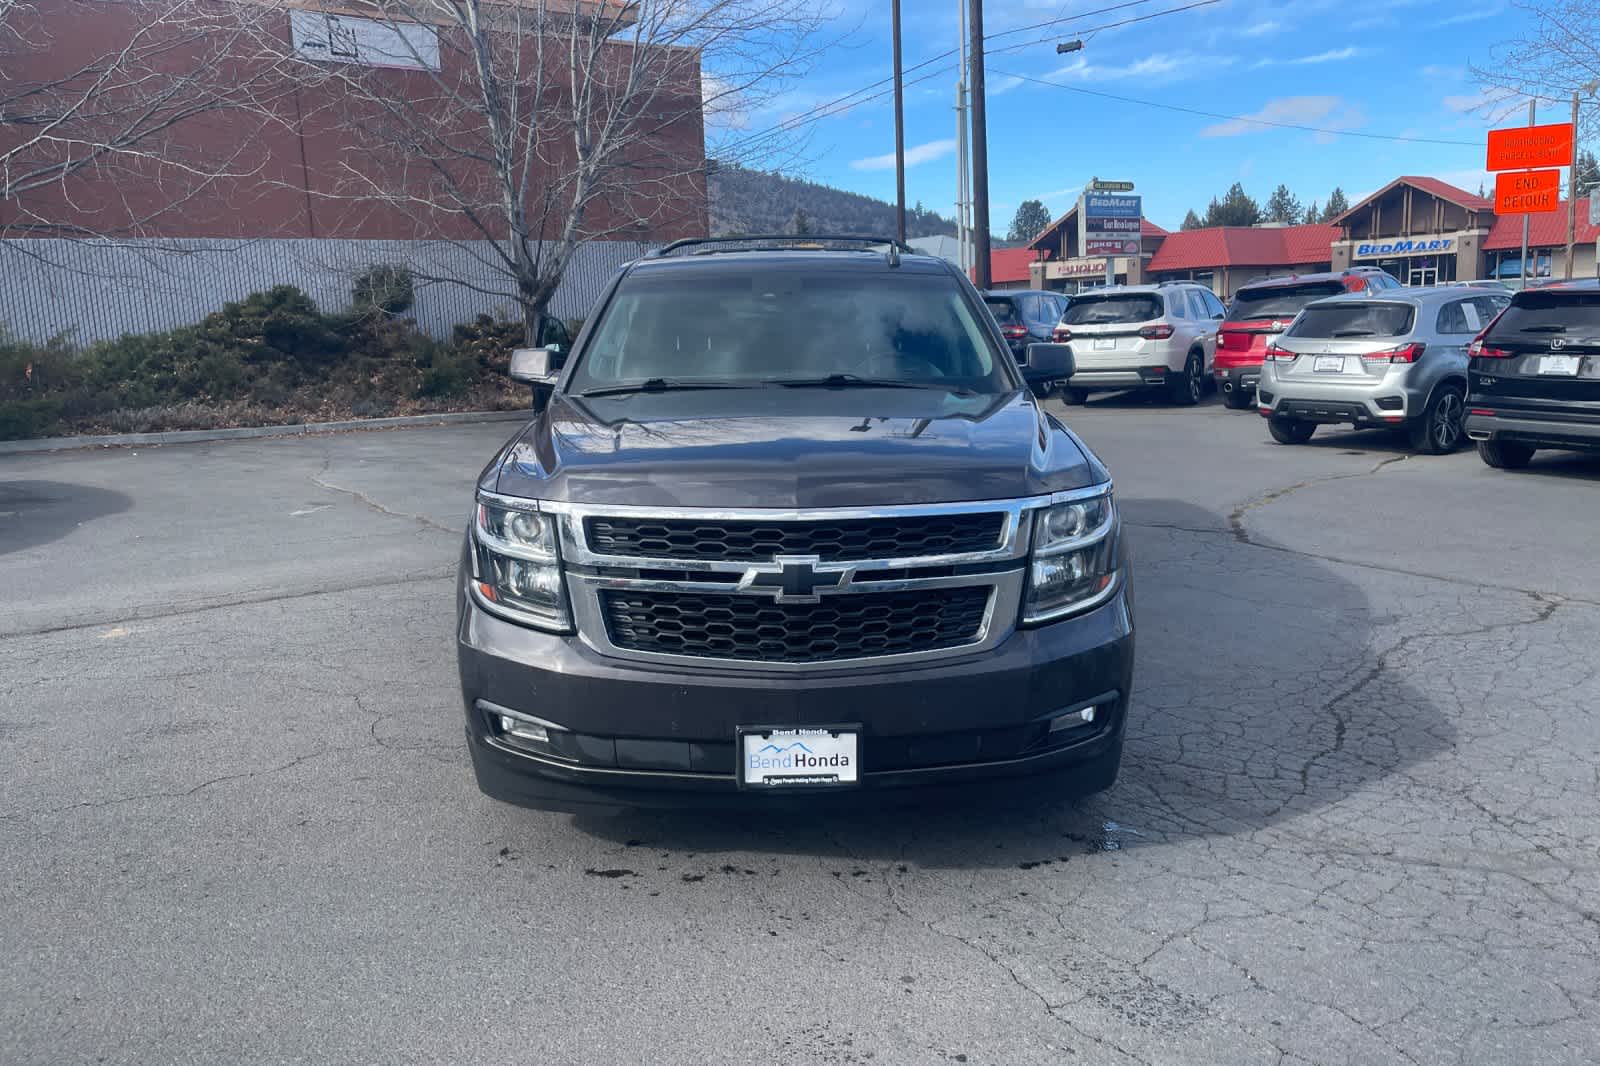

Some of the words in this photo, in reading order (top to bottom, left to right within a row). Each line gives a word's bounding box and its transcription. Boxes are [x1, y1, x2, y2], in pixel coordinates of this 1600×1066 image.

[1515, 176, 1539, 190] END
[1503, 194, 1549, 208] DETOUR
[798, 728, 829, 736] Honda
[749, 753, 792, 769] Bend
[794, 753, 849, 768] Honda
